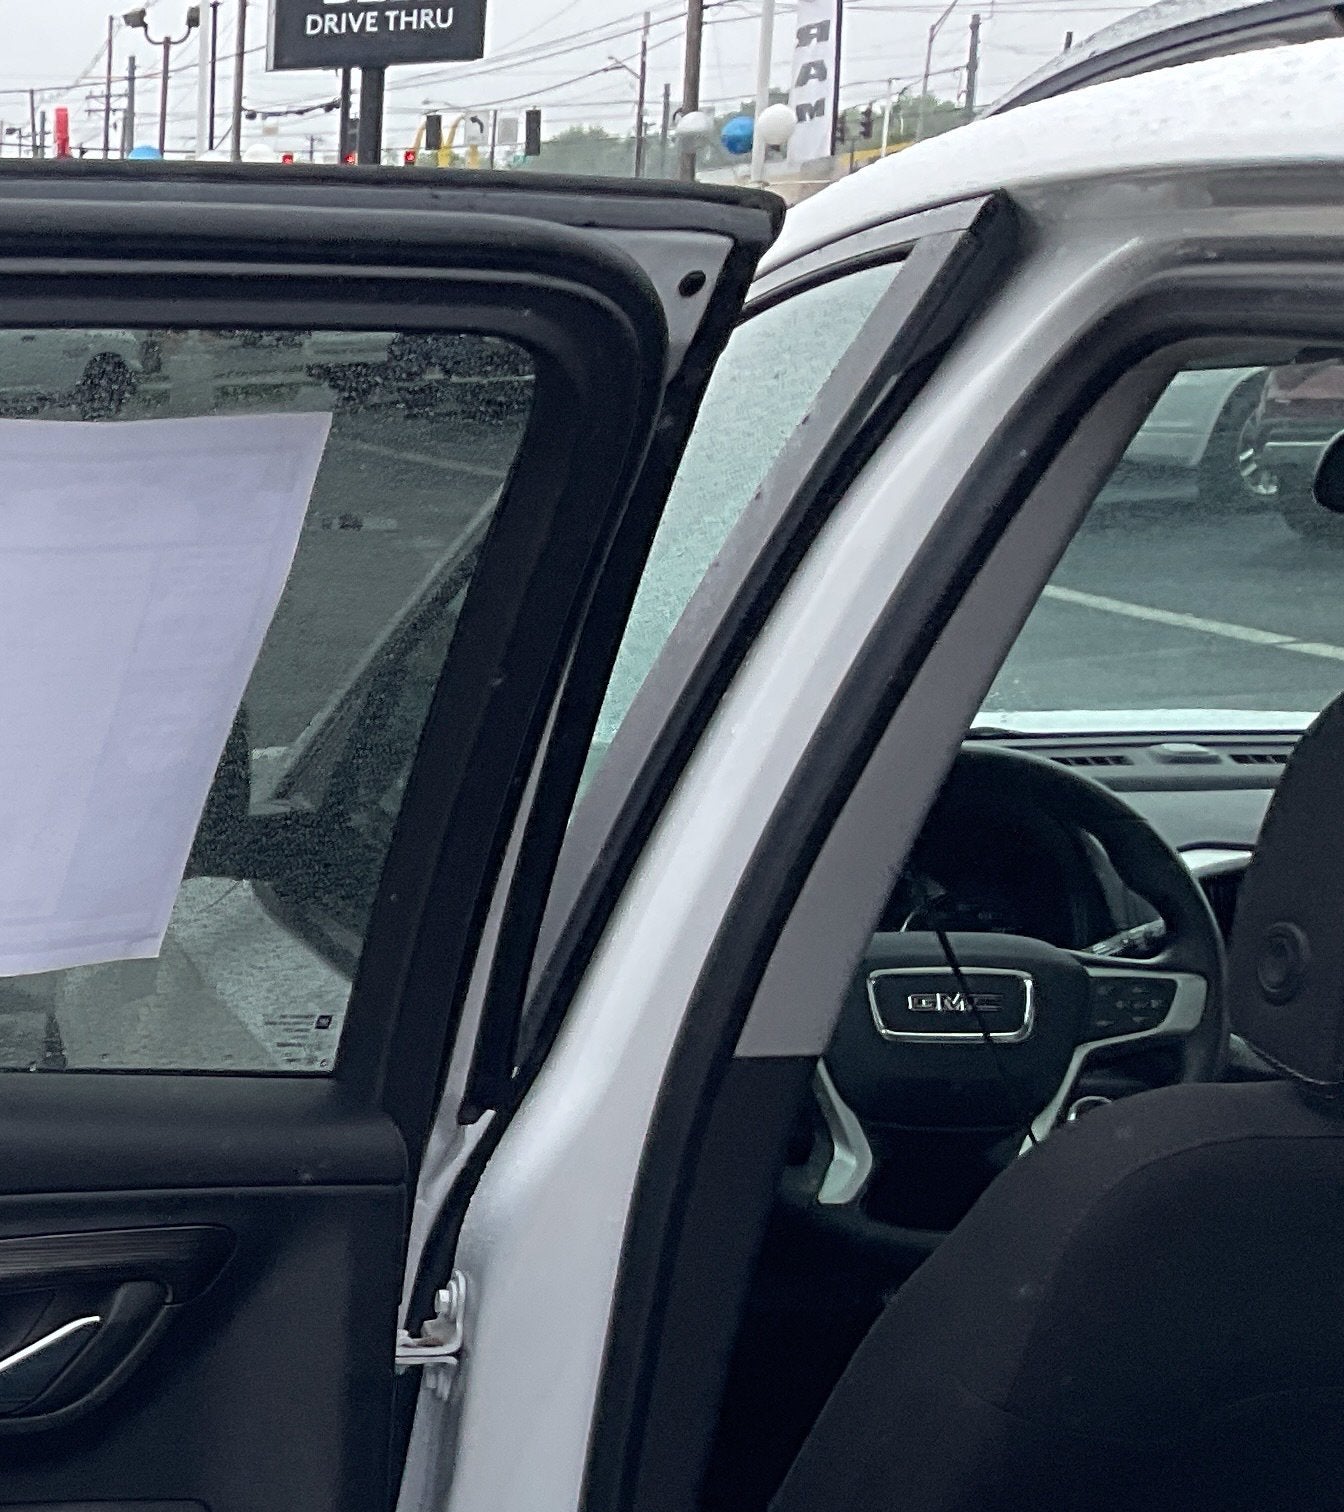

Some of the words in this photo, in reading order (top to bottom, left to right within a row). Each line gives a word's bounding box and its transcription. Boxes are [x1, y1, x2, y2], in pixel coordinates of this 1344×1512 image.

[305, 11, 378, 35] DRIVE
[384, 8, 454, 31] THRU
[907, 992, 1004, 1012] GMC
